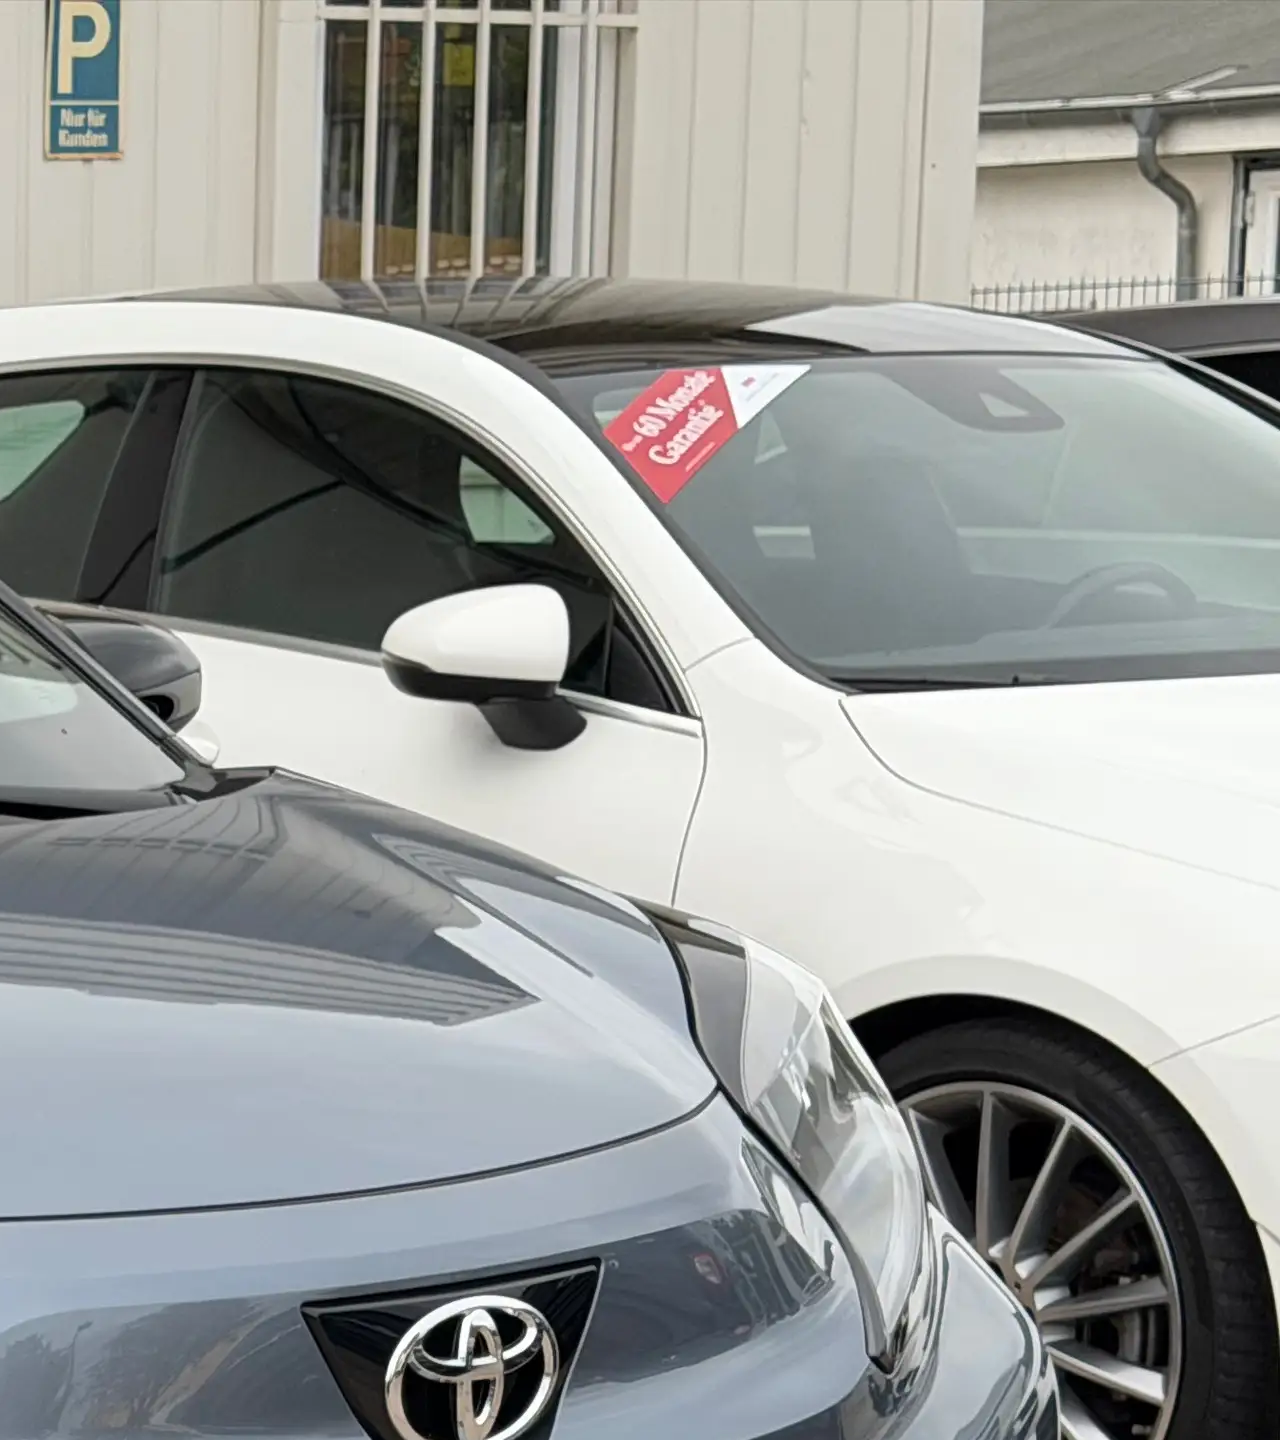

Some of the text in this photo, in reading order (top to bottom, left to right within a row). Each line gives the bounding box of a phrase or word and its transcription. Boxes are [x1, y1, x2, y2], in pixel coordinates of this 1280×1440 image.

[57, 1, 112, 94] P
[60, 108, 107, 127] Nur für
[58, 128, 109, 147] Kunden
[632, 408, 667, 438] 60
